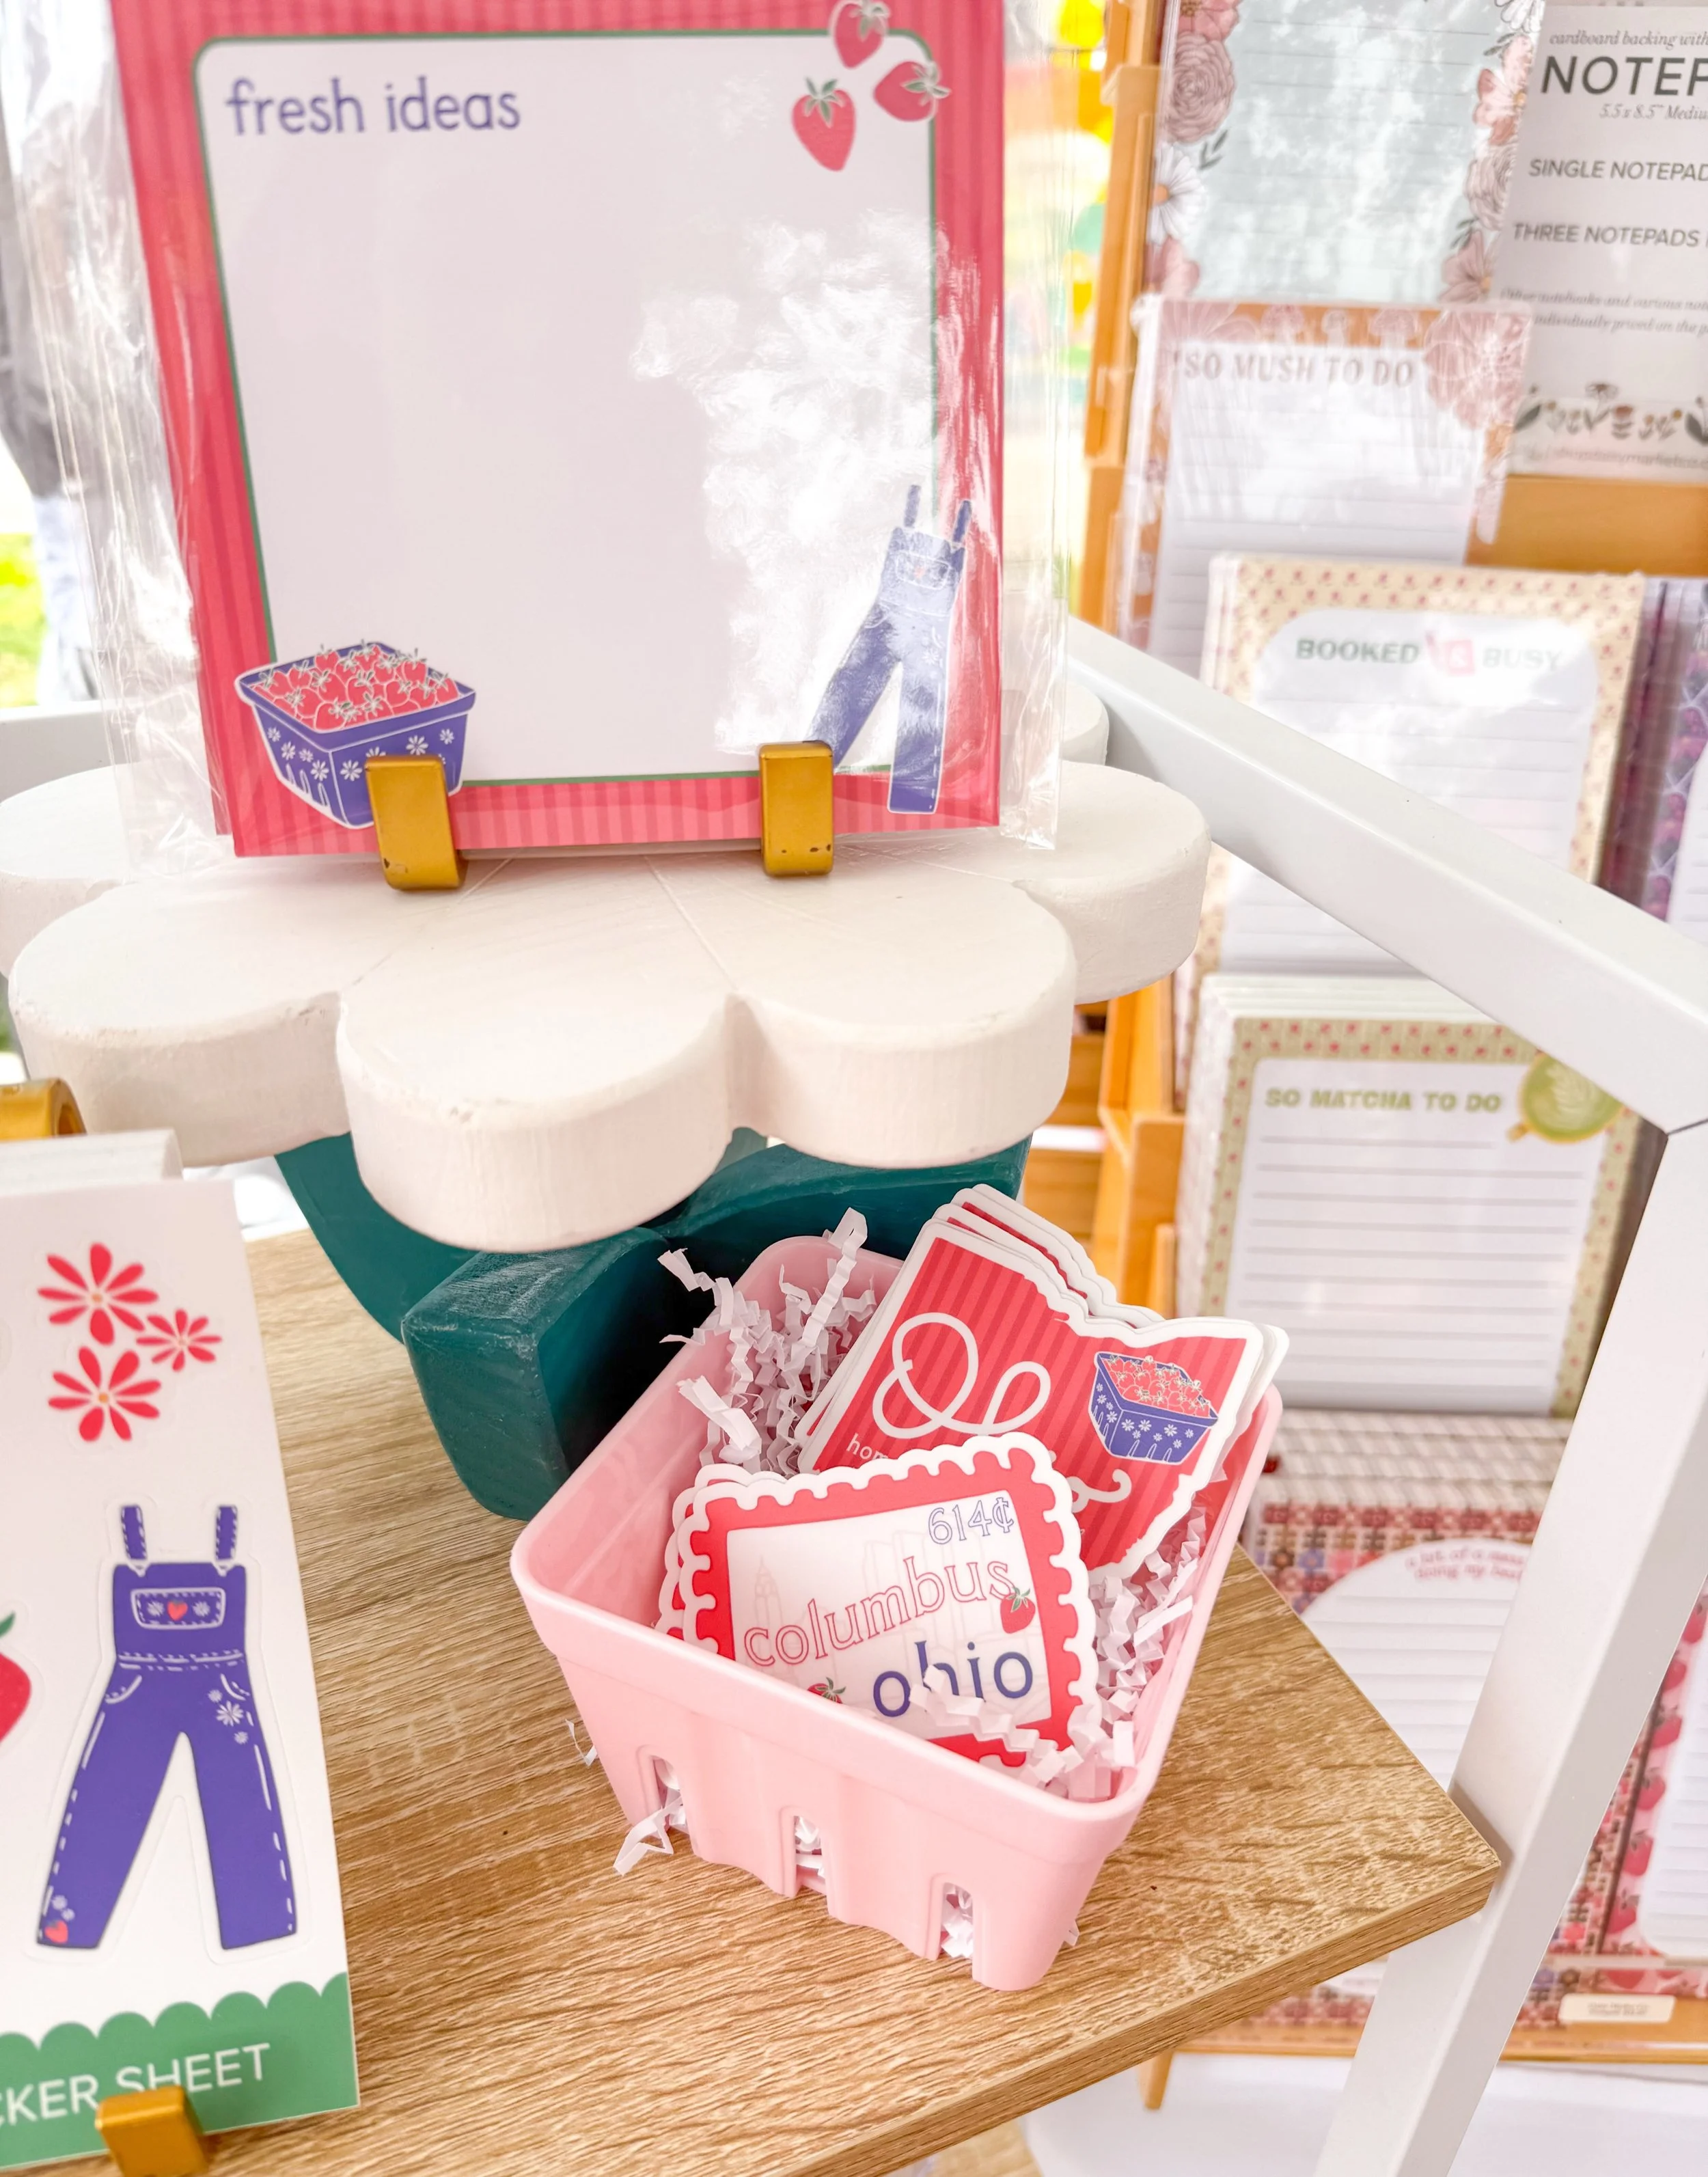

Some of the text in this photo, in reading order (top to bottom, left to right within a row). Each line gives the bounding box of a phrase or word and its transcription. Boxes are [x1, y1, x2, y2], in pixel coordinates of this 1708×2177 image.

[1549, 29, 1708, 51] cardboard backing with
[1541, 55, 1708, 96] NOTEP
[226, 74, 521, 135] fresh ideas
[1528, 159, 1708, 182] SINGLE NOTEPAD
[1512, 223, 1580, 243] THREE
[1583, 225, 1700, 248] NOTEPADS
[1183, 351, 1416, 388] SO MUSH TO DO
[1296, 638, 1419, 664] BOOKED
[1483, 648, 1562, 671] BUSY
[1265, 1088, 1502, 1114] SO MATCHA TO DO
[928, 1496, 1015, 1545] 614¢
[743, 1555, 1015, 1667] columbus
[872, 1639, 1034, 1717] ohio
[0, 2042, 270, 2126] KER SHEET
